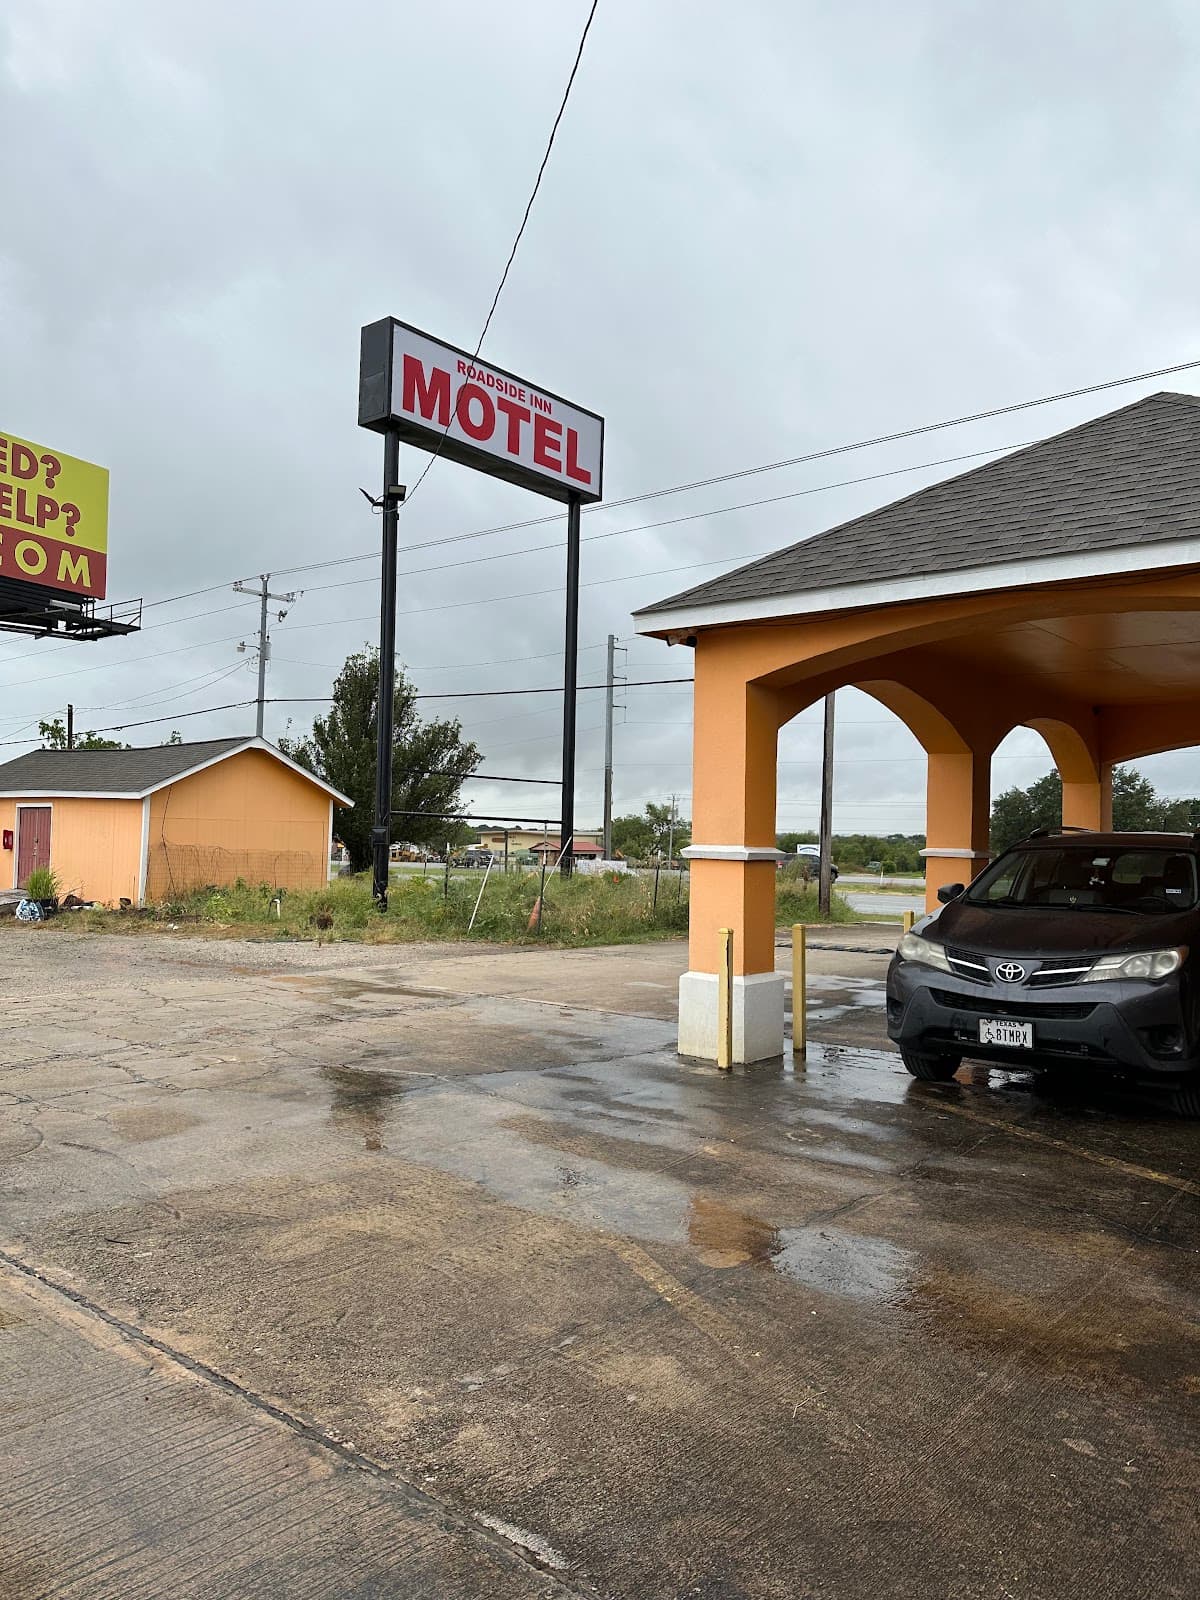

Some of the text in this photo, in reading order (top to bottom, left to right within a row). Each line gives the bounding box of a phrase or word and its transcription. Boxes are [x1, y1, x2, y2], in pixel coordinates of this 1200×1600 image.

[457, 359, 552, 414] ROADSIDE INN
[402, 353, 591, 485] MOTEL
[0, 533, 91, 588] OM
[995, 1020, 1017, 1028] TEXAS
